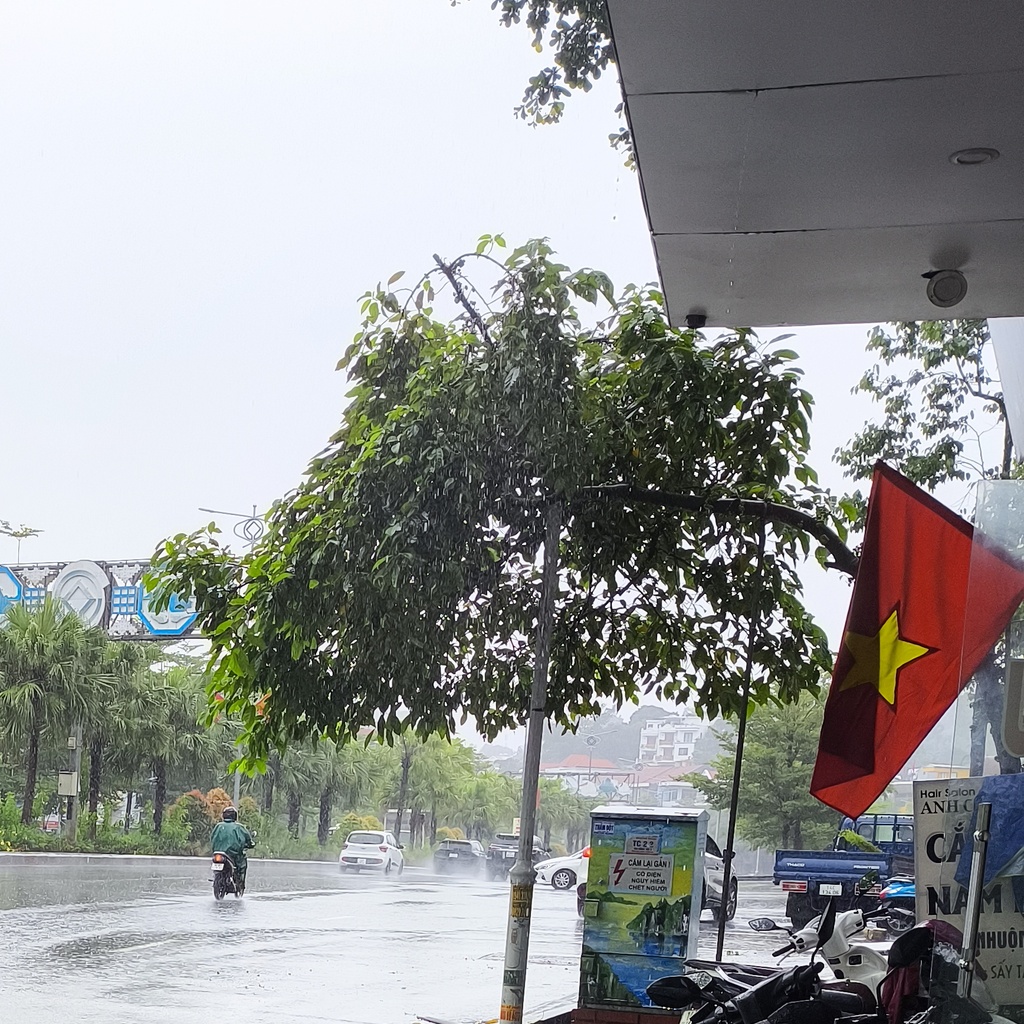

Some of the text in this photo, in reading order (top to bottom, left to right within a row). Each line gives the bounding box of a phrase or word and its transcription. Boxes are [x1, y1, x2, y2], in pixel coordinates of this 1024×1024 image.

[920, 787, 976, 798] Hair Salon
[920, 800, 958, 814] ANH
[991, 958, 1012, 979] SẤY
